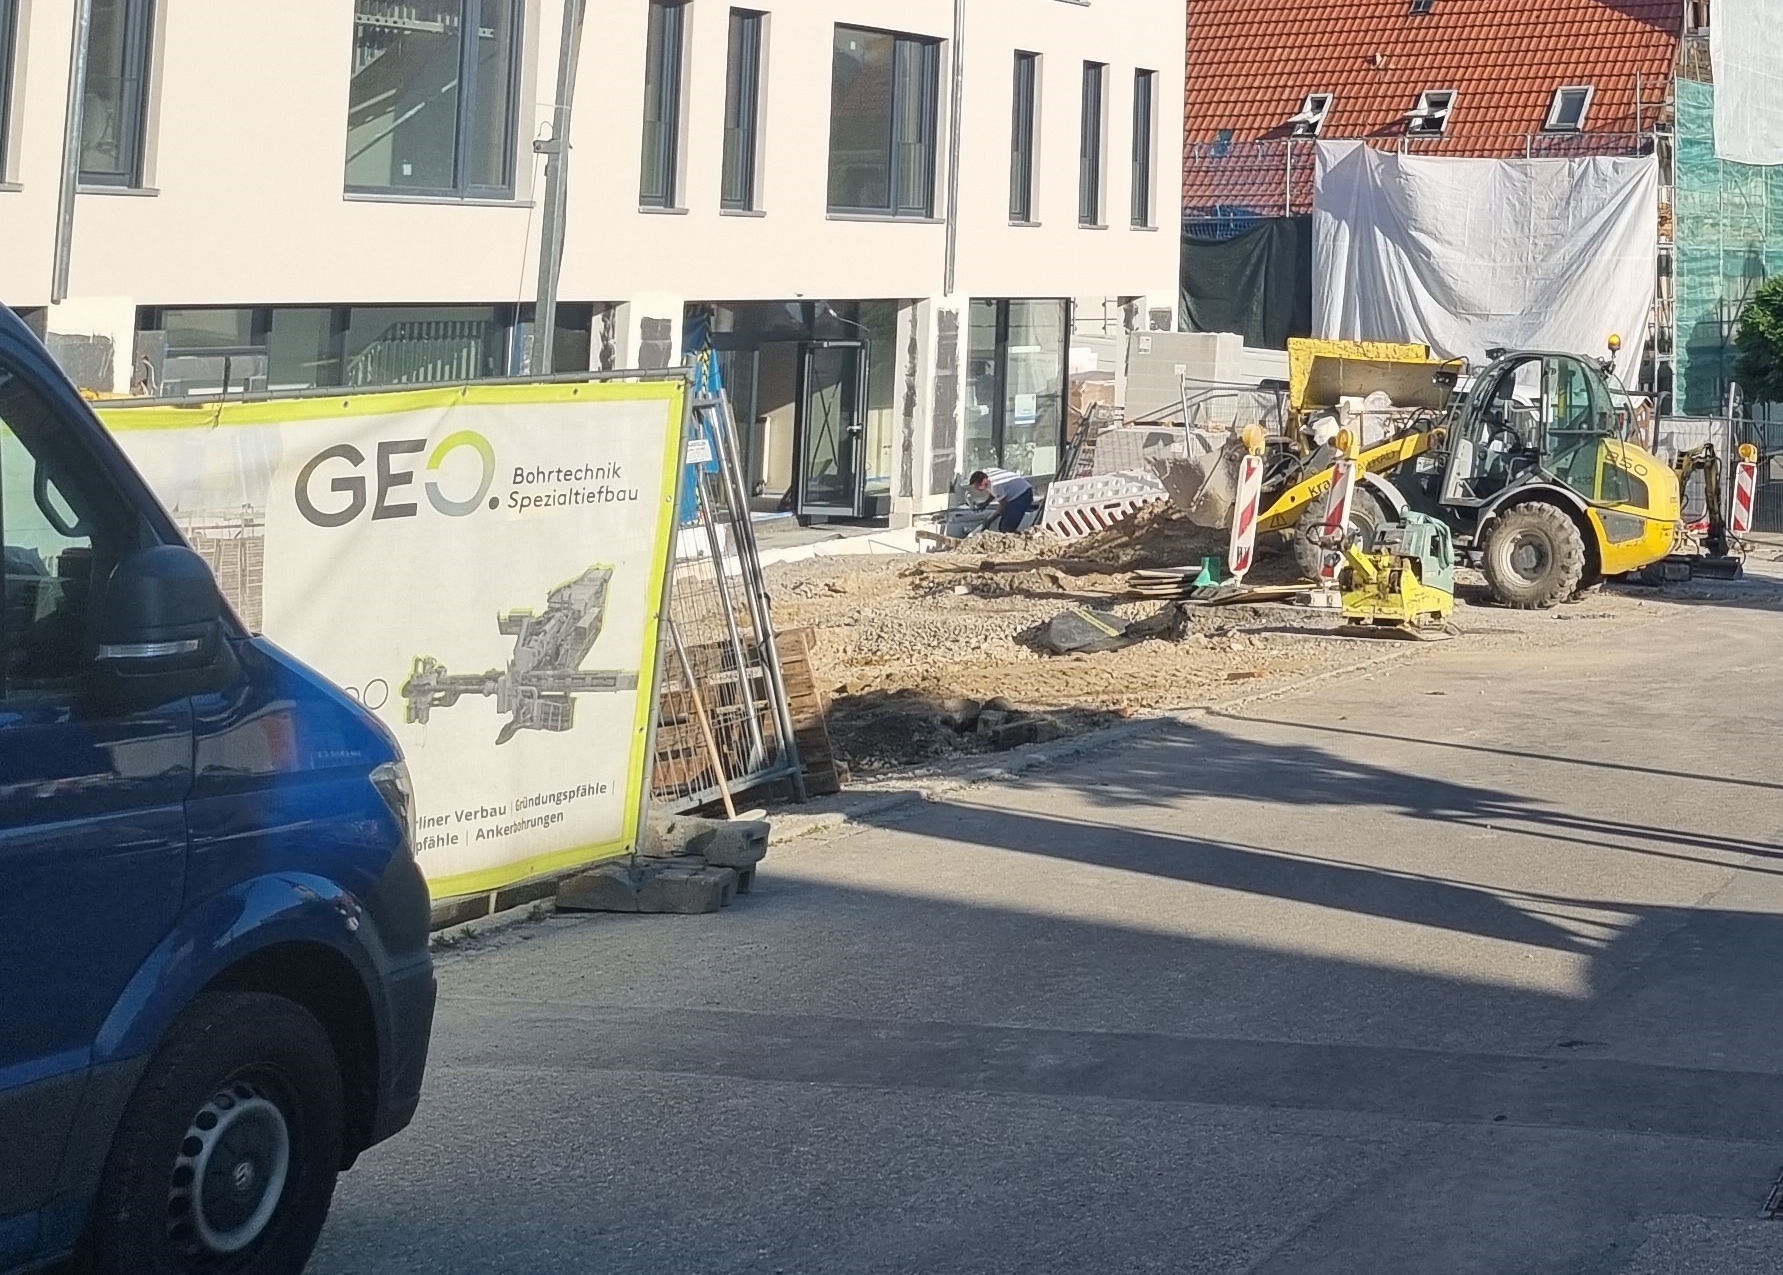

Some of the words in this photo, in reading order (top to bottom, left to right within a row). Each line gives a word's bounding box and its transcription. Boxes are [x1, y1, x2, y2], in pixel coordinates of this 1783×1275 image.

[512, 462, 622, 485] Bohrtechnik
[1605, 451, 1648, 476] 850
[507, 486, 639, 514] Spezialtiefbau
[1308, 479, 1331, 498] kra
[416, 814, 451, 830] liner
[455, 804, 507, 824] Verbau
[515, 781, 607, 812] Gründungspfähle
[475, 810, 564, 841] Ankerbohrungen
